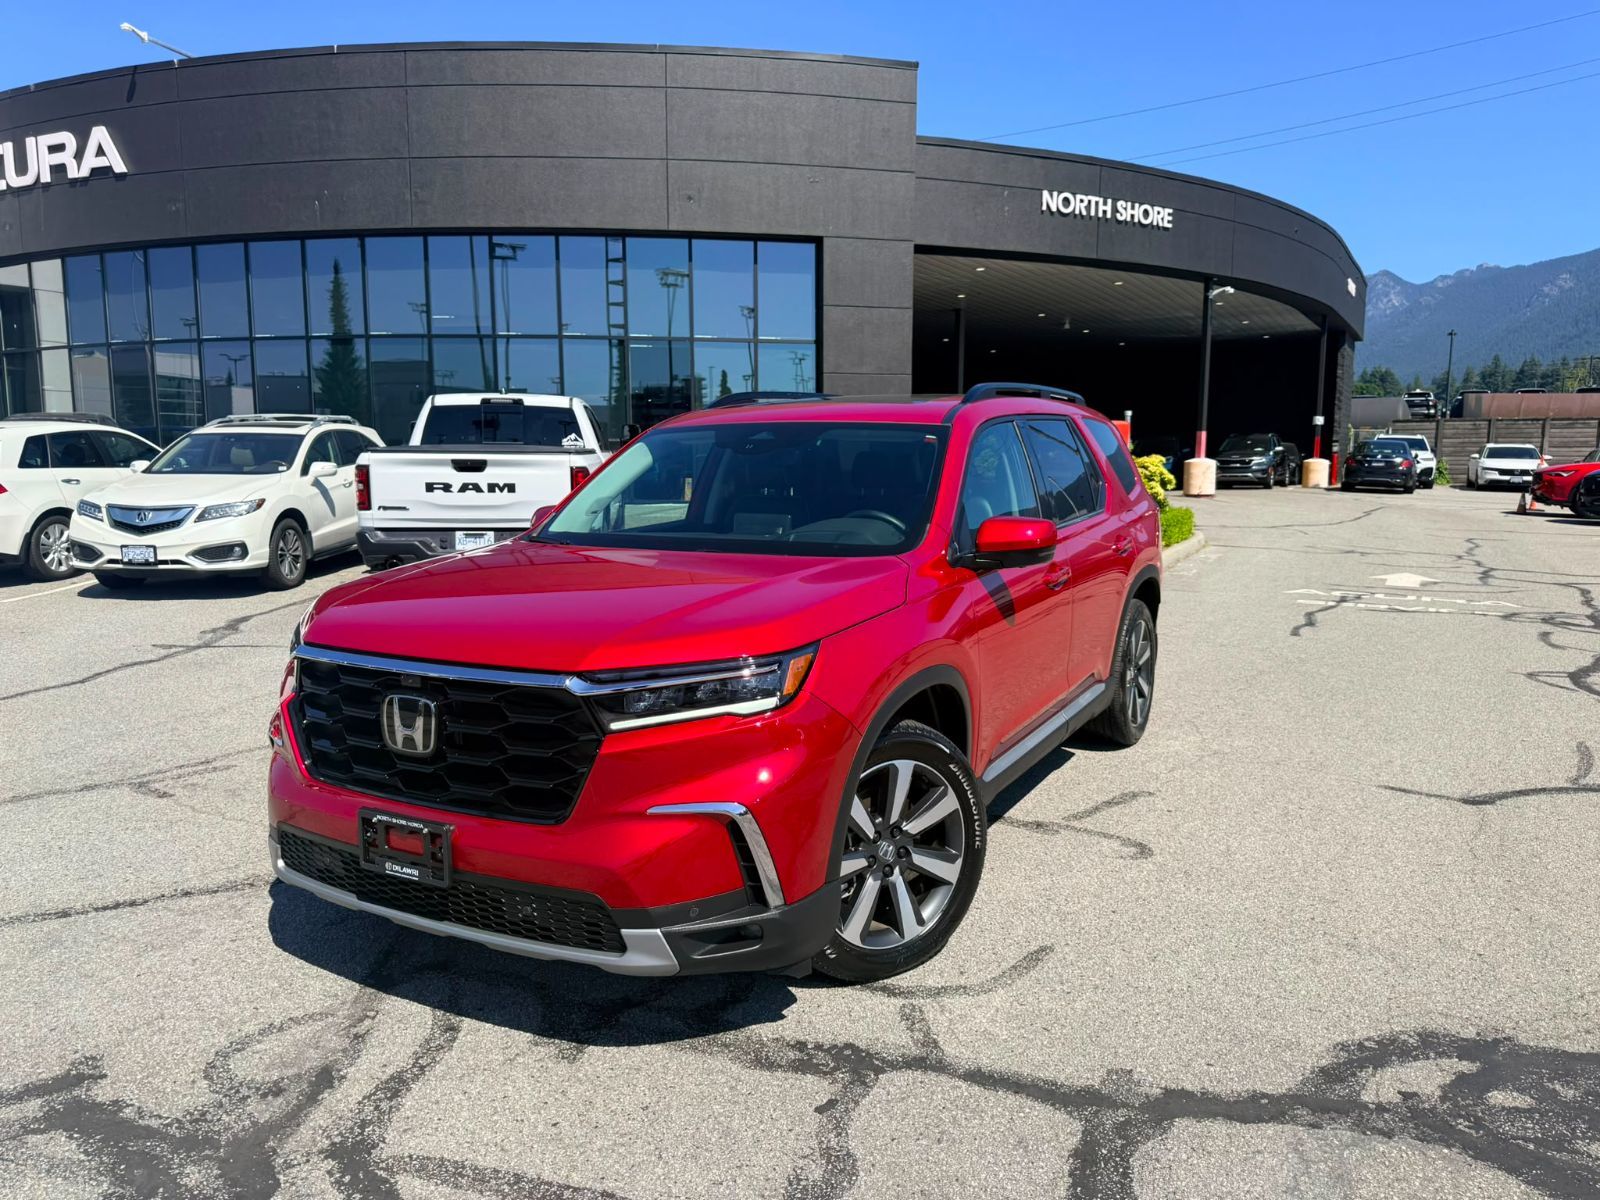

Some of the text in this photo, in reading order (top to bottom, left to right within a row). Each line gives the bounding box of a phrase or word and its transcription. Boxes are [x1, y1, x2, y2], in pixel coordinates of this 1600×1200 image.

[0, 125, 128, 191] URA
[1041, 189, 1173, 229] NORTH SHORE
[425, 482, 516, 494] RAM
[392, 864, 419, 877] DILAWRI
